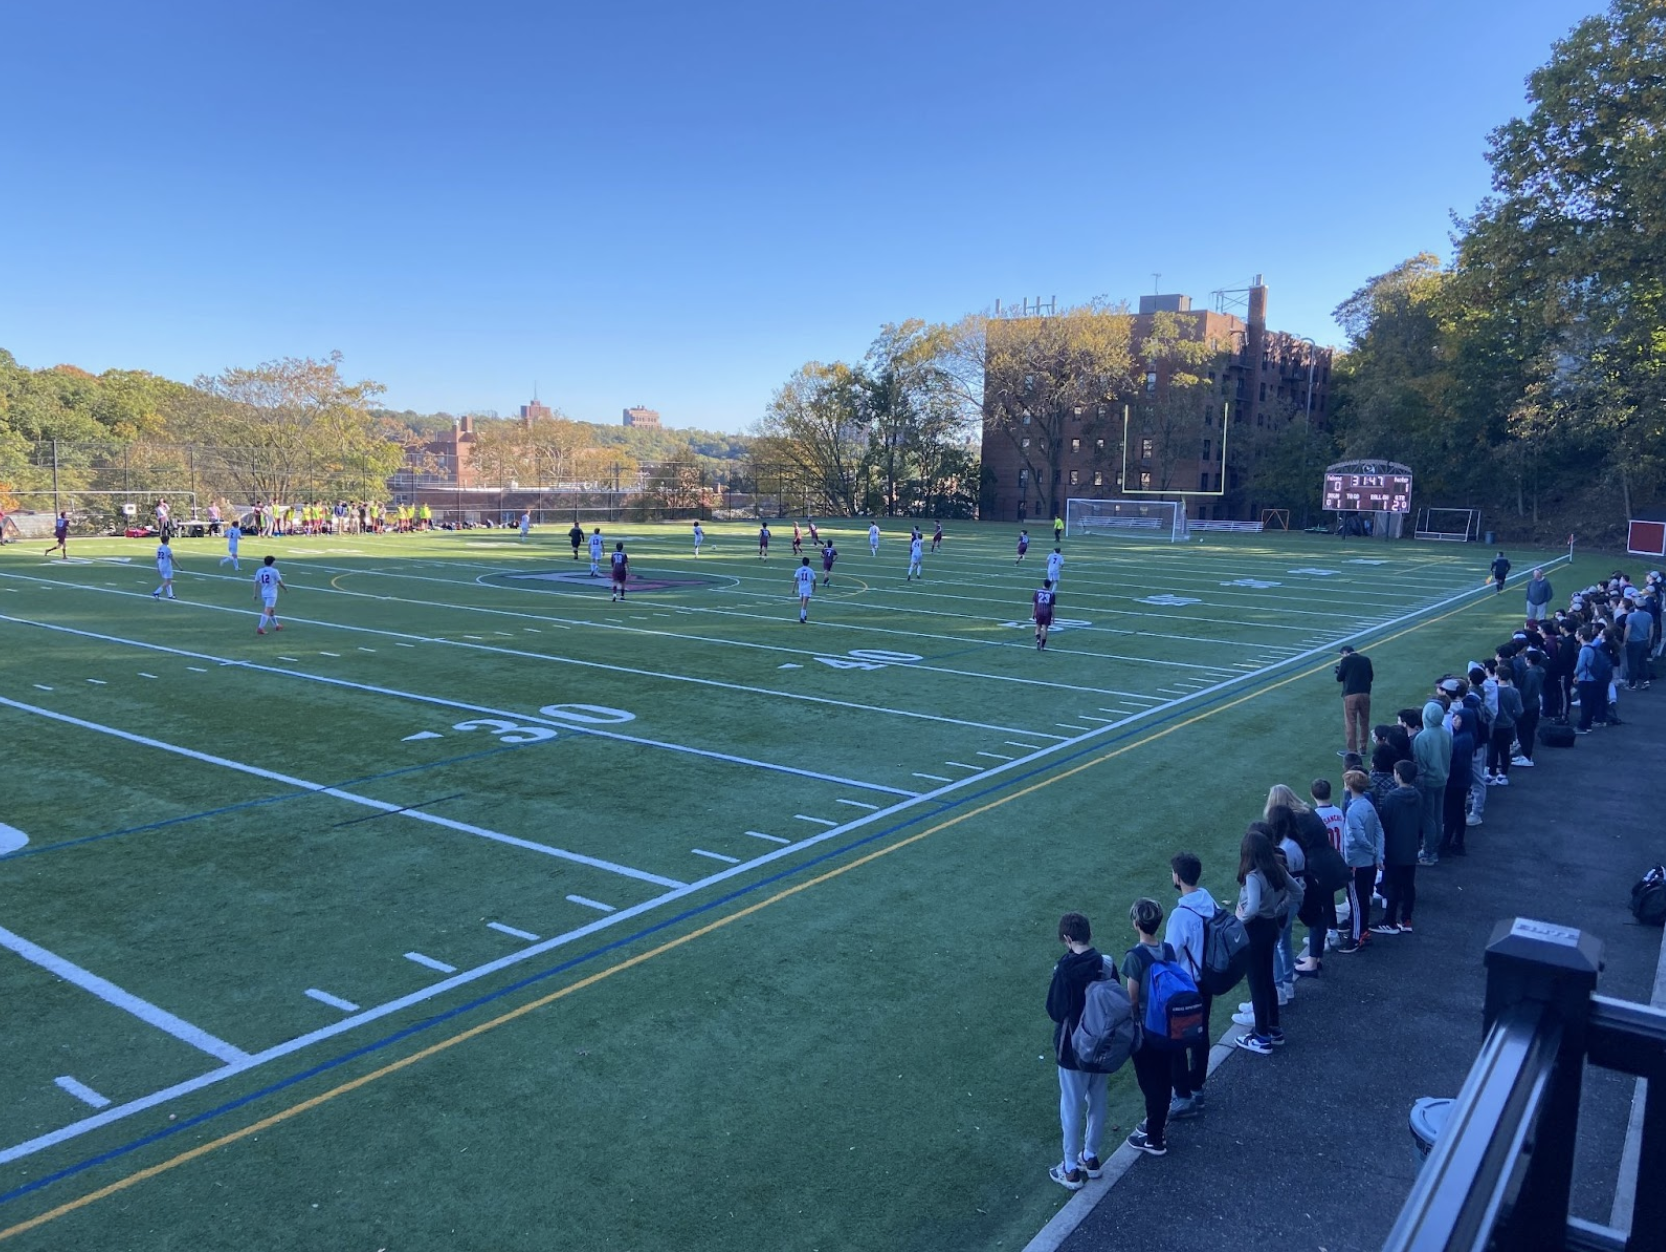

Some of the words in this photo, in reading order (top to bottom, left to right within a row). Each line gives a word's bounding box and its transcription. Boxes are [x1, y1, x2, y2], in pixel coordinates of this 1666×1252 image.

[1335, 482, 1341, 491] 0
[1405, 483, 1409, 492] 1
[1357, 500, 1360, 509] 1
[1383, 501, 1387, 510] 1
[1392, 501, 1399, 510] 2
[261, 574, 270, 584] 12
[1038, 592, 1051, 603] 23
[813, 649, 923, 671] 40
[452, 703, 637, 743] 30
[1515, 923, 1578, 940] ELITE
